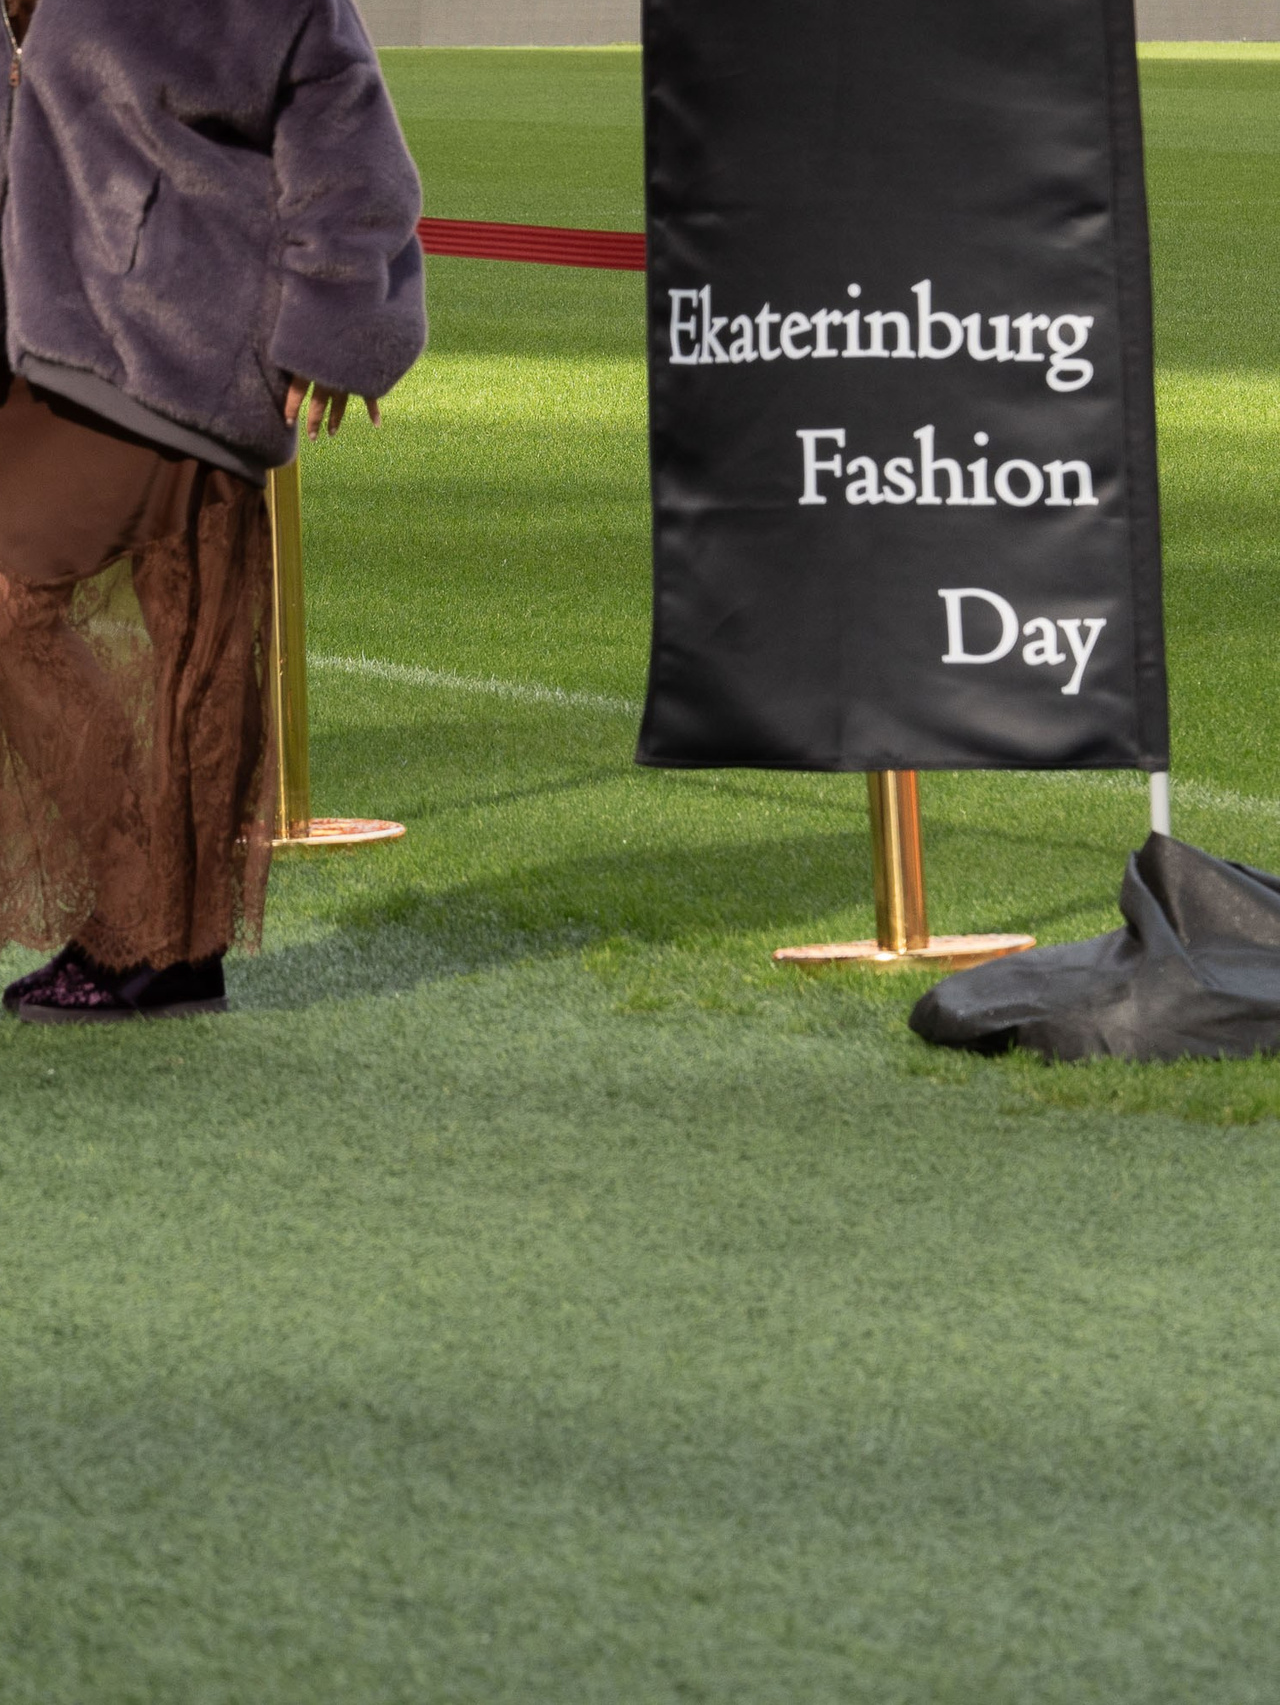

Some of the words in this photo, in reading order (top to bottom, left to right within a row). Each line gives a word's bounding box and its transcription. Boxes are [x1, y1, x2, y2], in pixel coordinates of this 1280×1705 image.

[668, 279, 1095, 393] Ekaterinburg
[796, 425, 1099, 507] Fashion
[937, 587, 1107, 695] Day
